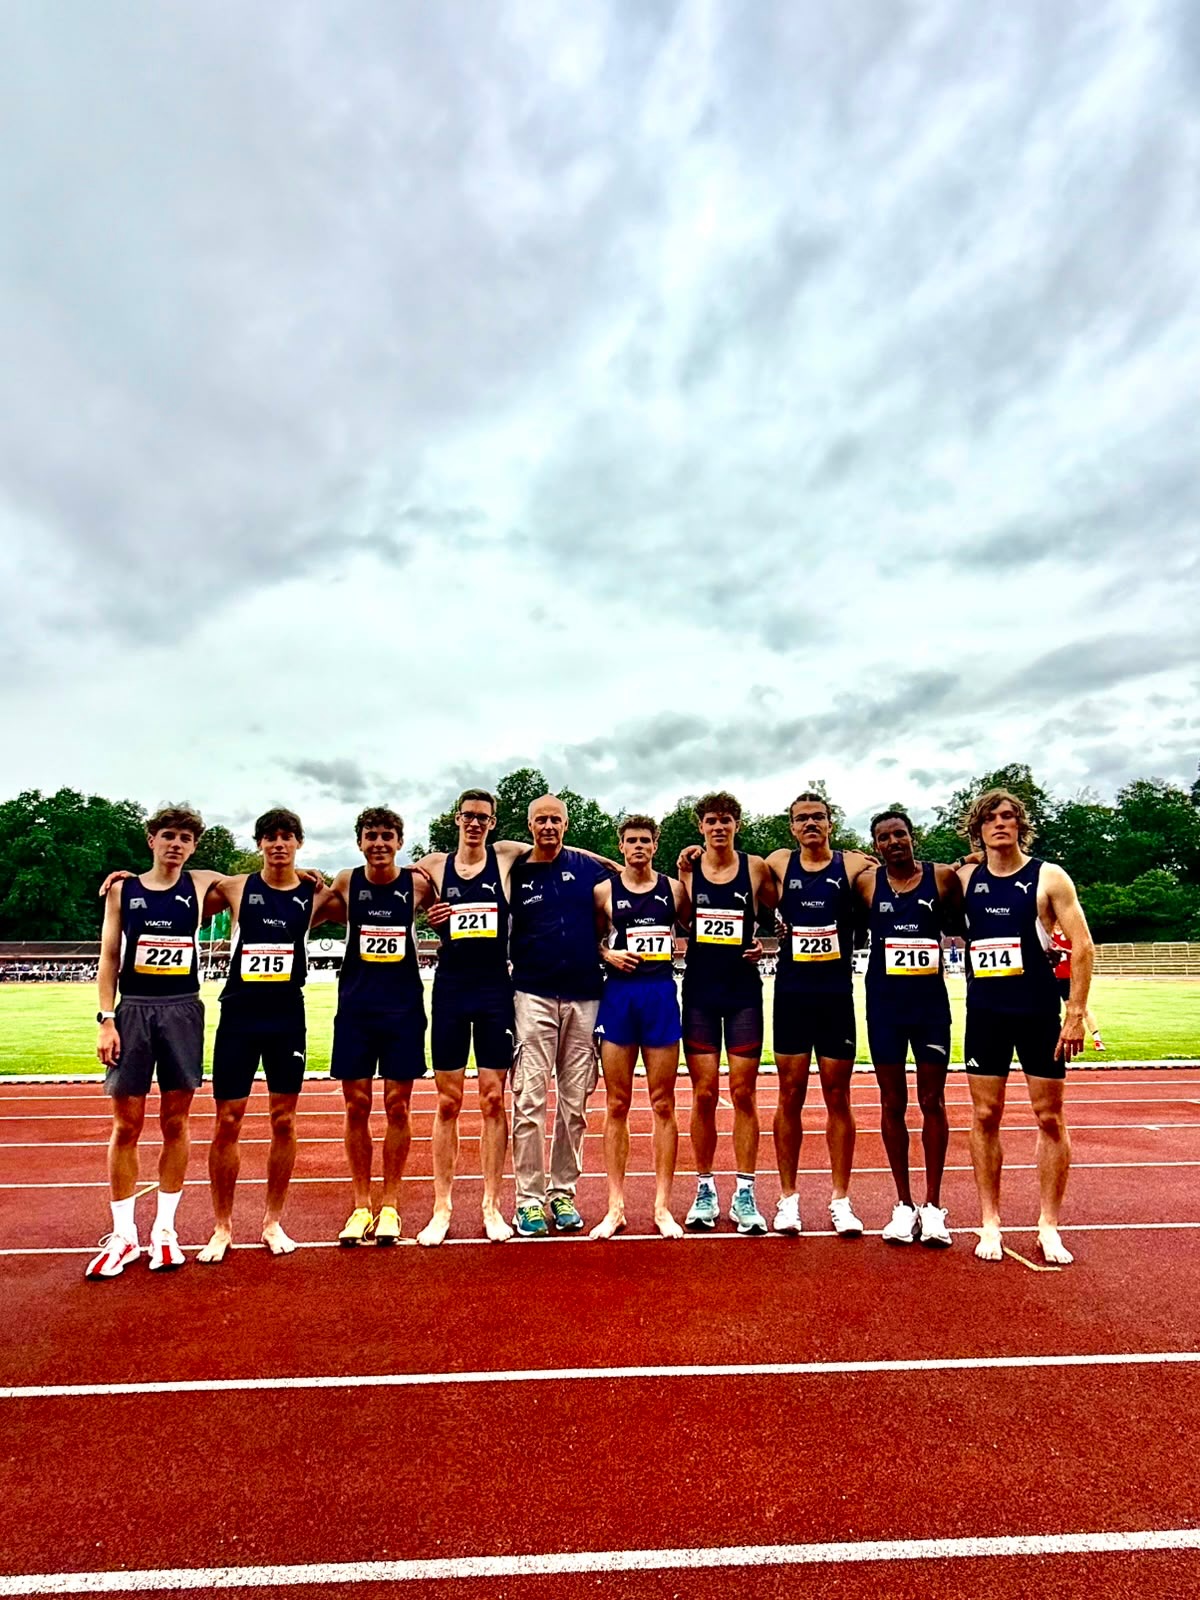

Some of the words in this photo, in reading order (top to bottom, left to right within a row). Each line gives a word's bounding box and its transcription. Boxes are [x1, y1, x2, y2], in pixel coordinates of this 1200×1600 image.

[458, 913, 487, 930] 221
[704, 920, 734, 937] 225
[366, 938, 398, 954] 226
[635, 937, 665, 952] 217
[799, 938, 832, 954] 228
[144, 948, 183, 966] 224
[248, 956, 284, 973] 215
[894, 950, 930, 967] 216
[978, 950, 1011, 968] 214
